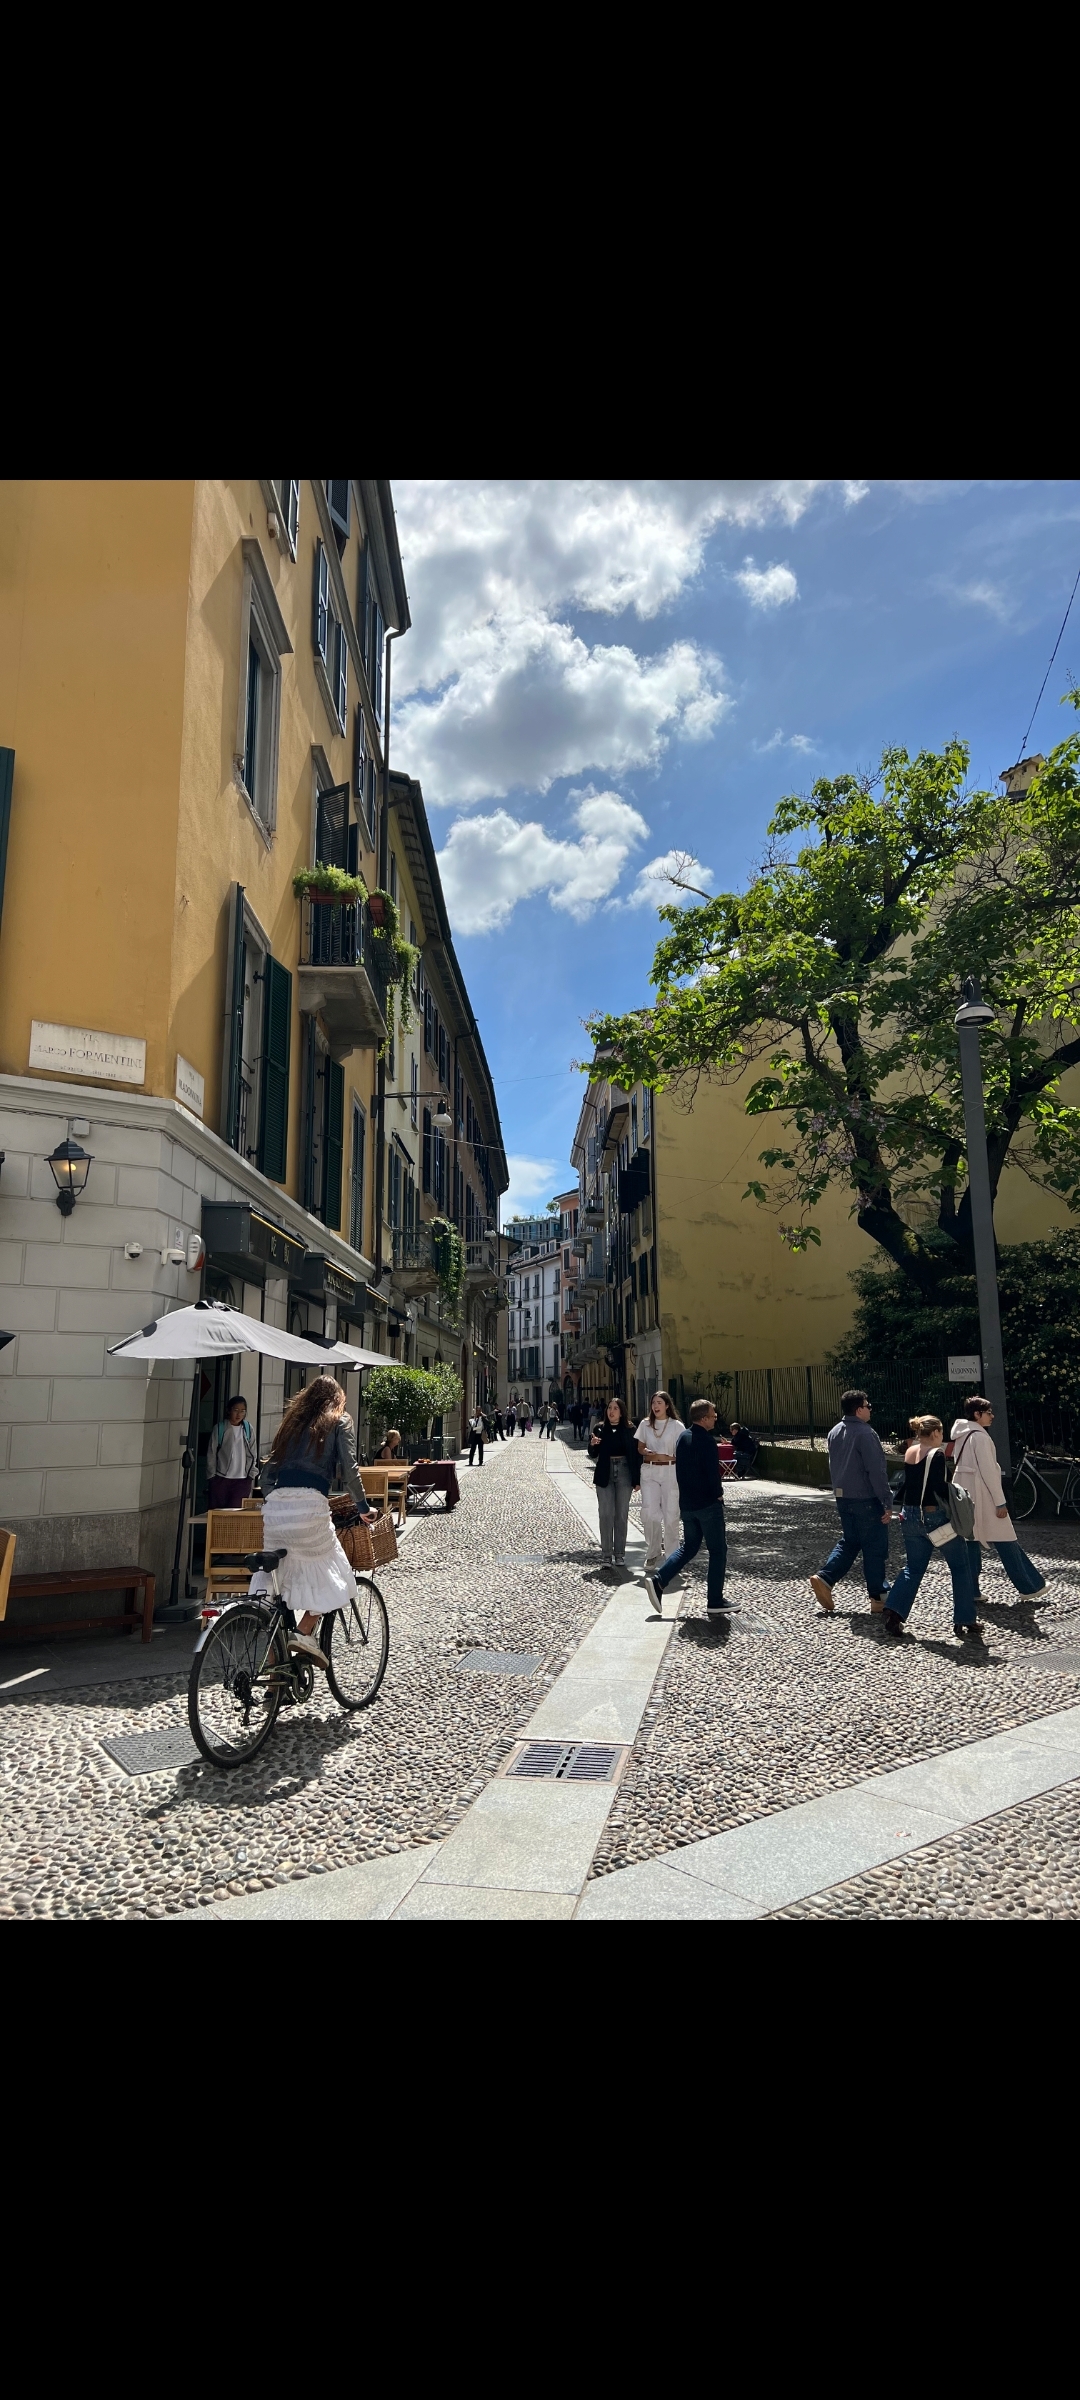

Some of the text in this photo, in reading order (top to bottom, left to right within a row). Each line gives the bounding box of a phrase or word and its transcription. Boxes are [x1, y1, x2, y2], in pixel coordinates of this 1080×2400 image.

[81, 1032, 99, 1043] VIA
[34, 1044, 142, 1069] MARCO FORMENTINI
